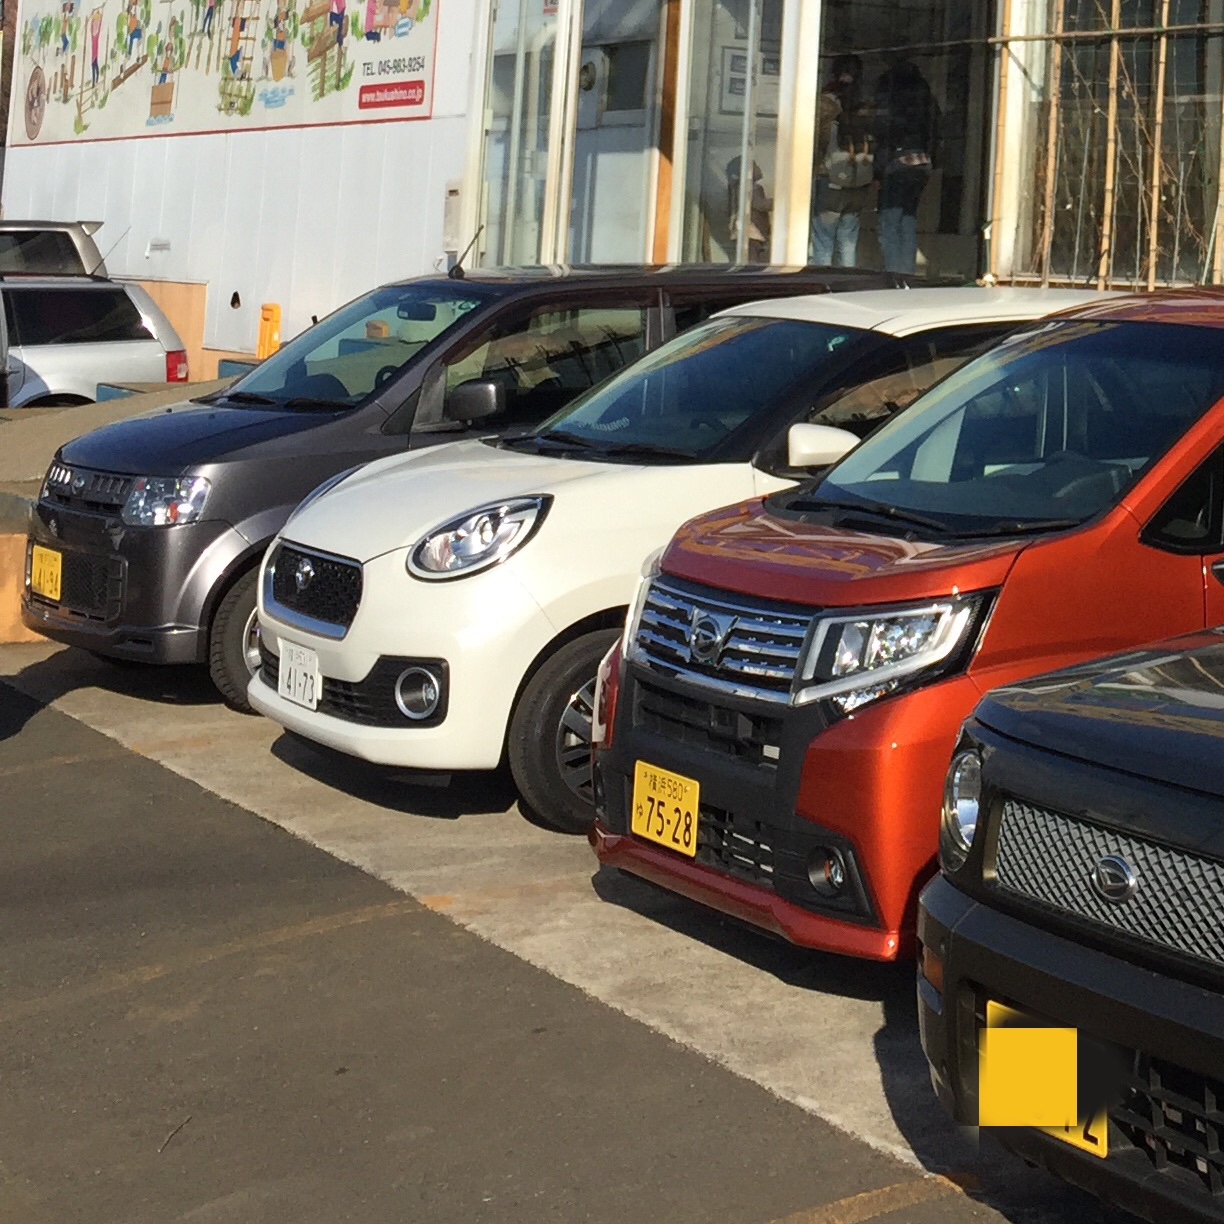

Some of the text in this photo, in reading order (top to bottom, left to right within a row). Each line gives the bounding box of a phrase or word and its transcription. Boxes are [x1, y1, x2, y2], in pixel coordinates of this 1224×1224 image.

[362, 62, 376, 77] TEL
[286, 666, 315, 704] 41-73
[646, 795, 693, 848] 75-28
